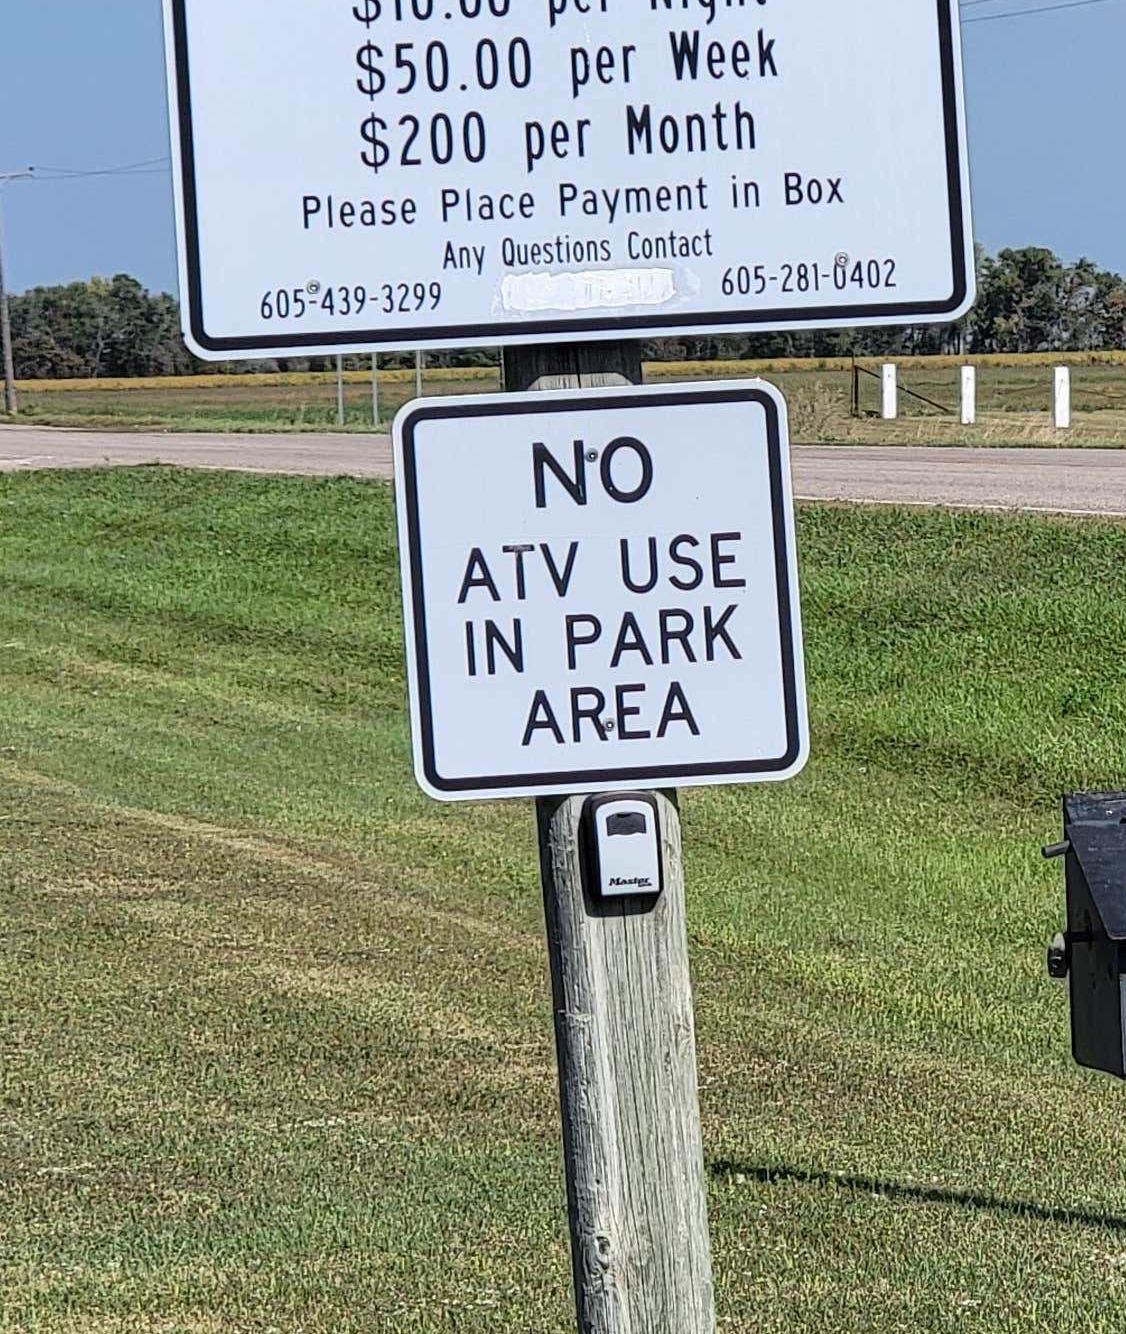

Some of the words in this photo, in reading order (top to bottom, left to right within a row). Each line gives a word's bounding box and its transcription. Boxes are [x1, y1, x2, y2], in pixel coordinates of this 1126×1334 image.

[357, 37, 531, 97] $50.00
[571, 45, 635, 98] per
[670, 29, 779, 80] Week
[361, 112, 485, 173] $200
[526, 120, 590, 172] per
[627, 102, 755, 154] Month
[303, 196, 416, 229] Please
[442, 189, 534, 222] Place
[560, 178, 707, 223] Payment
[732, 175, 759, 207] in
[785, 173, 843, 205] Box
[443, 241, 484, 274] Any
[503, 236, 610, 266] Questions
[628, 229, 712, 259] Contact
[722, 256, 896, 295] 605-281-0402
[260, 282, 441, 319] 605-439-3299
[533, 437, 653, 508] NO
[458, 542, 578, 603] ATV
[620, 532, 746, 593] USE
[466, 619, 523, 676] IN
[566, 605, 742, 670] PARK
[522, 682, 700, 746] AREA
[609, 877, 650, 886] Master
